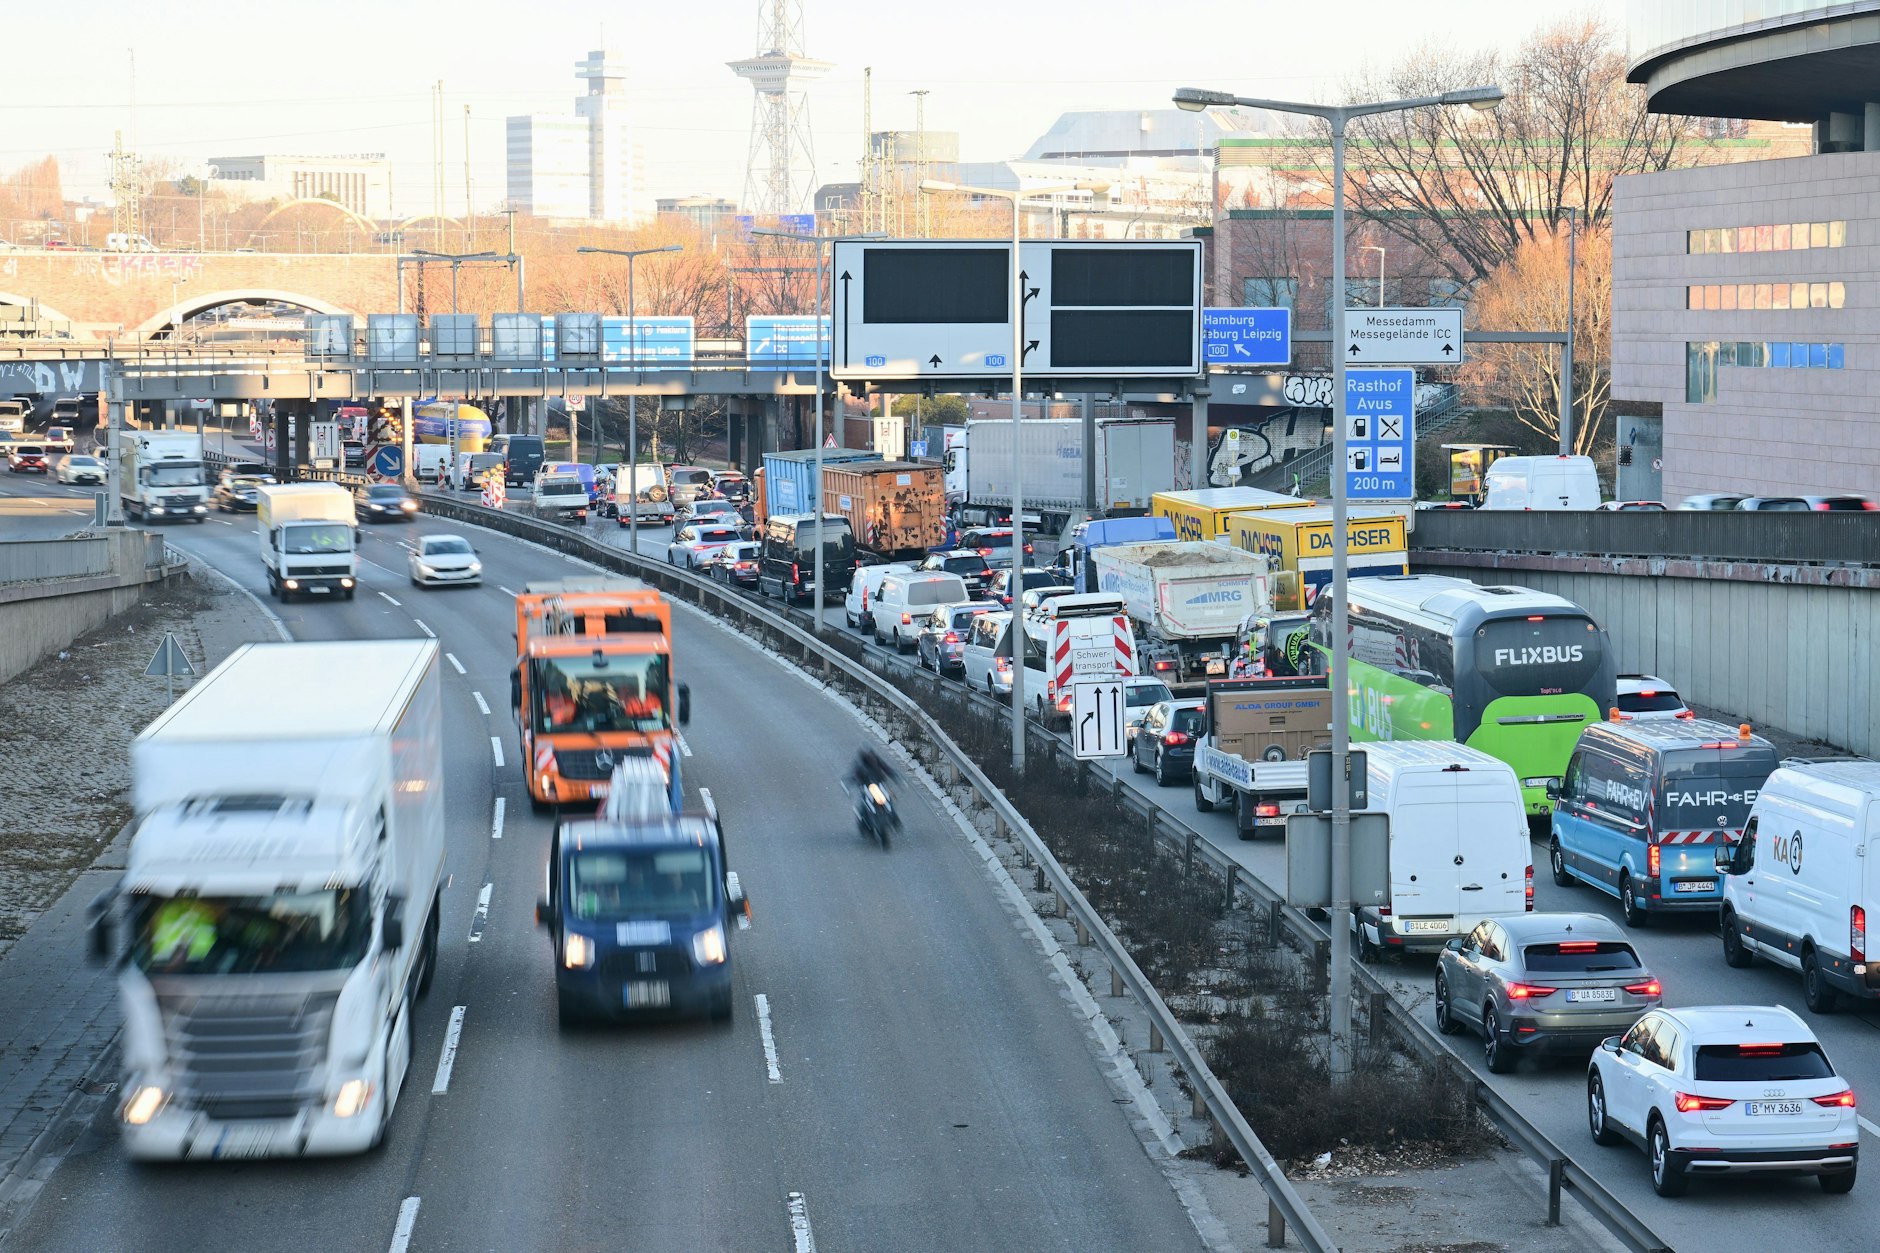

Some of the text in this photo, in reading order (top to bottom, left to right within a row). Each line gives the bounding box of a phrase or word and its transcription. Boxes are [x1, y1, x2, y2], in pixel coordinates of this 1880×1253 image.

[1204, 315, 1255, 327] Hamburg
[1366, 316, 1436, 326] Messedamm
[1243, 329, 1282, 342] Leipzig
[1350, 329, 1452, 341] Messegelände ICC
[1211, 346, 1225, 355] 100
[868, 357, 883, 366] 100
[988, 357, 1003, 366] 100
[1347, 379, 1402, 392] Rasthof
[1357, 397, 1393, 410] Avus
[1354, 477, 1395, 490] 200 m
[1310, 528, 1391, 550] DAHSER
[1207, 590, 1242, 602] MRG
[1076, 651, 1110, 659] Schwer-
[1075, 661, 1114, 671] transport
[1667, 790, 1761, 807] FAHR E
[1773, 835, 1789, 864] KA
[1410, 920, 1447, 930] B LE 4006
[1571, 991, 1577, 1000] B
[1752, 1102, 1802, 1114] B MY 3636
